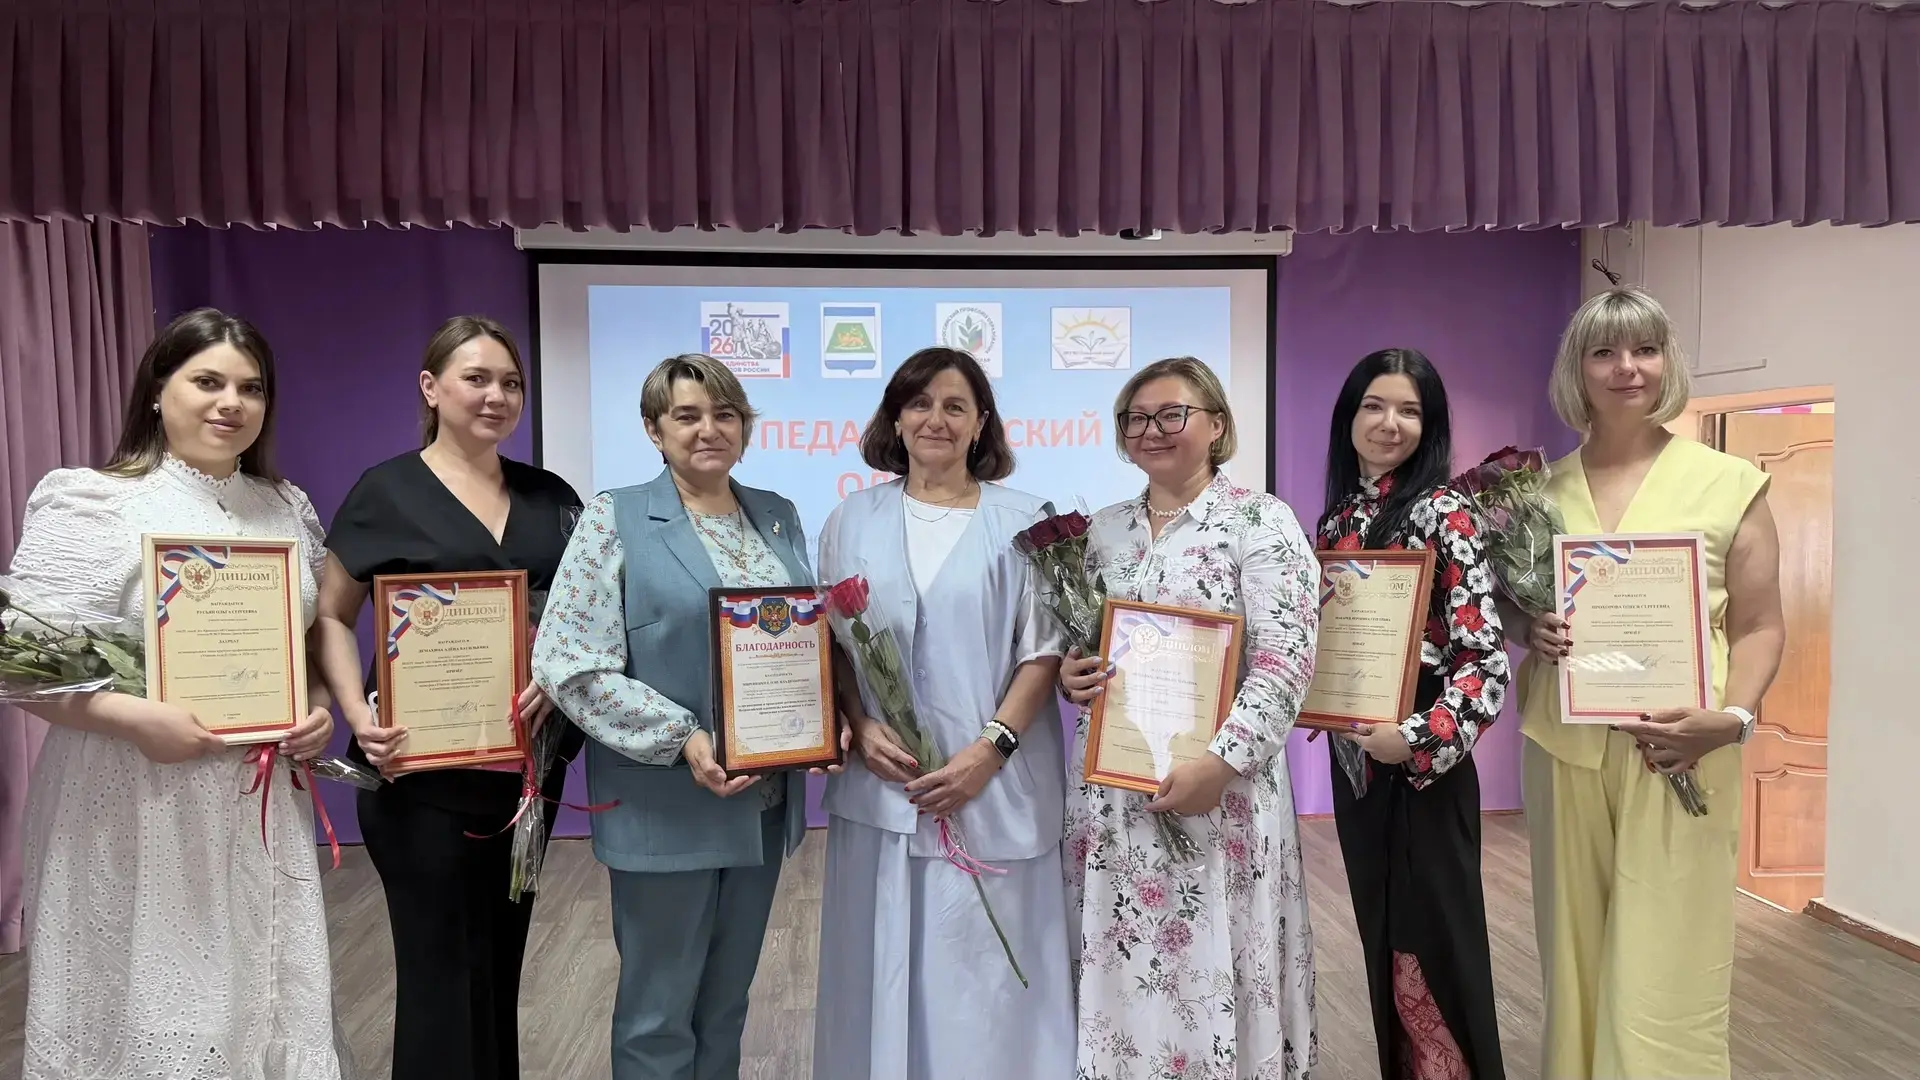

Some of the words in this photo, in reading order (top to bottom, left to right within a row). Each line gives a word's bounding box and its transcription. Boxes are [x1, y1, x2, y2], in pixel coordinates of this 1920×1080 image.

[710, 319, 734, 336] 20
[711, 337, 734, 354] 26
[760, 409, 1102, 456] ПЕДАСКИЙ
[216, 571, 270, 582] ДИПЛОМ
[1619, 565, 1676, 576] ДИПЛОМ
[444, 605, 498, 618] ДИПЛОМ
[736, 641, 815, 652] БЛАГОДАРНОСТЬ
